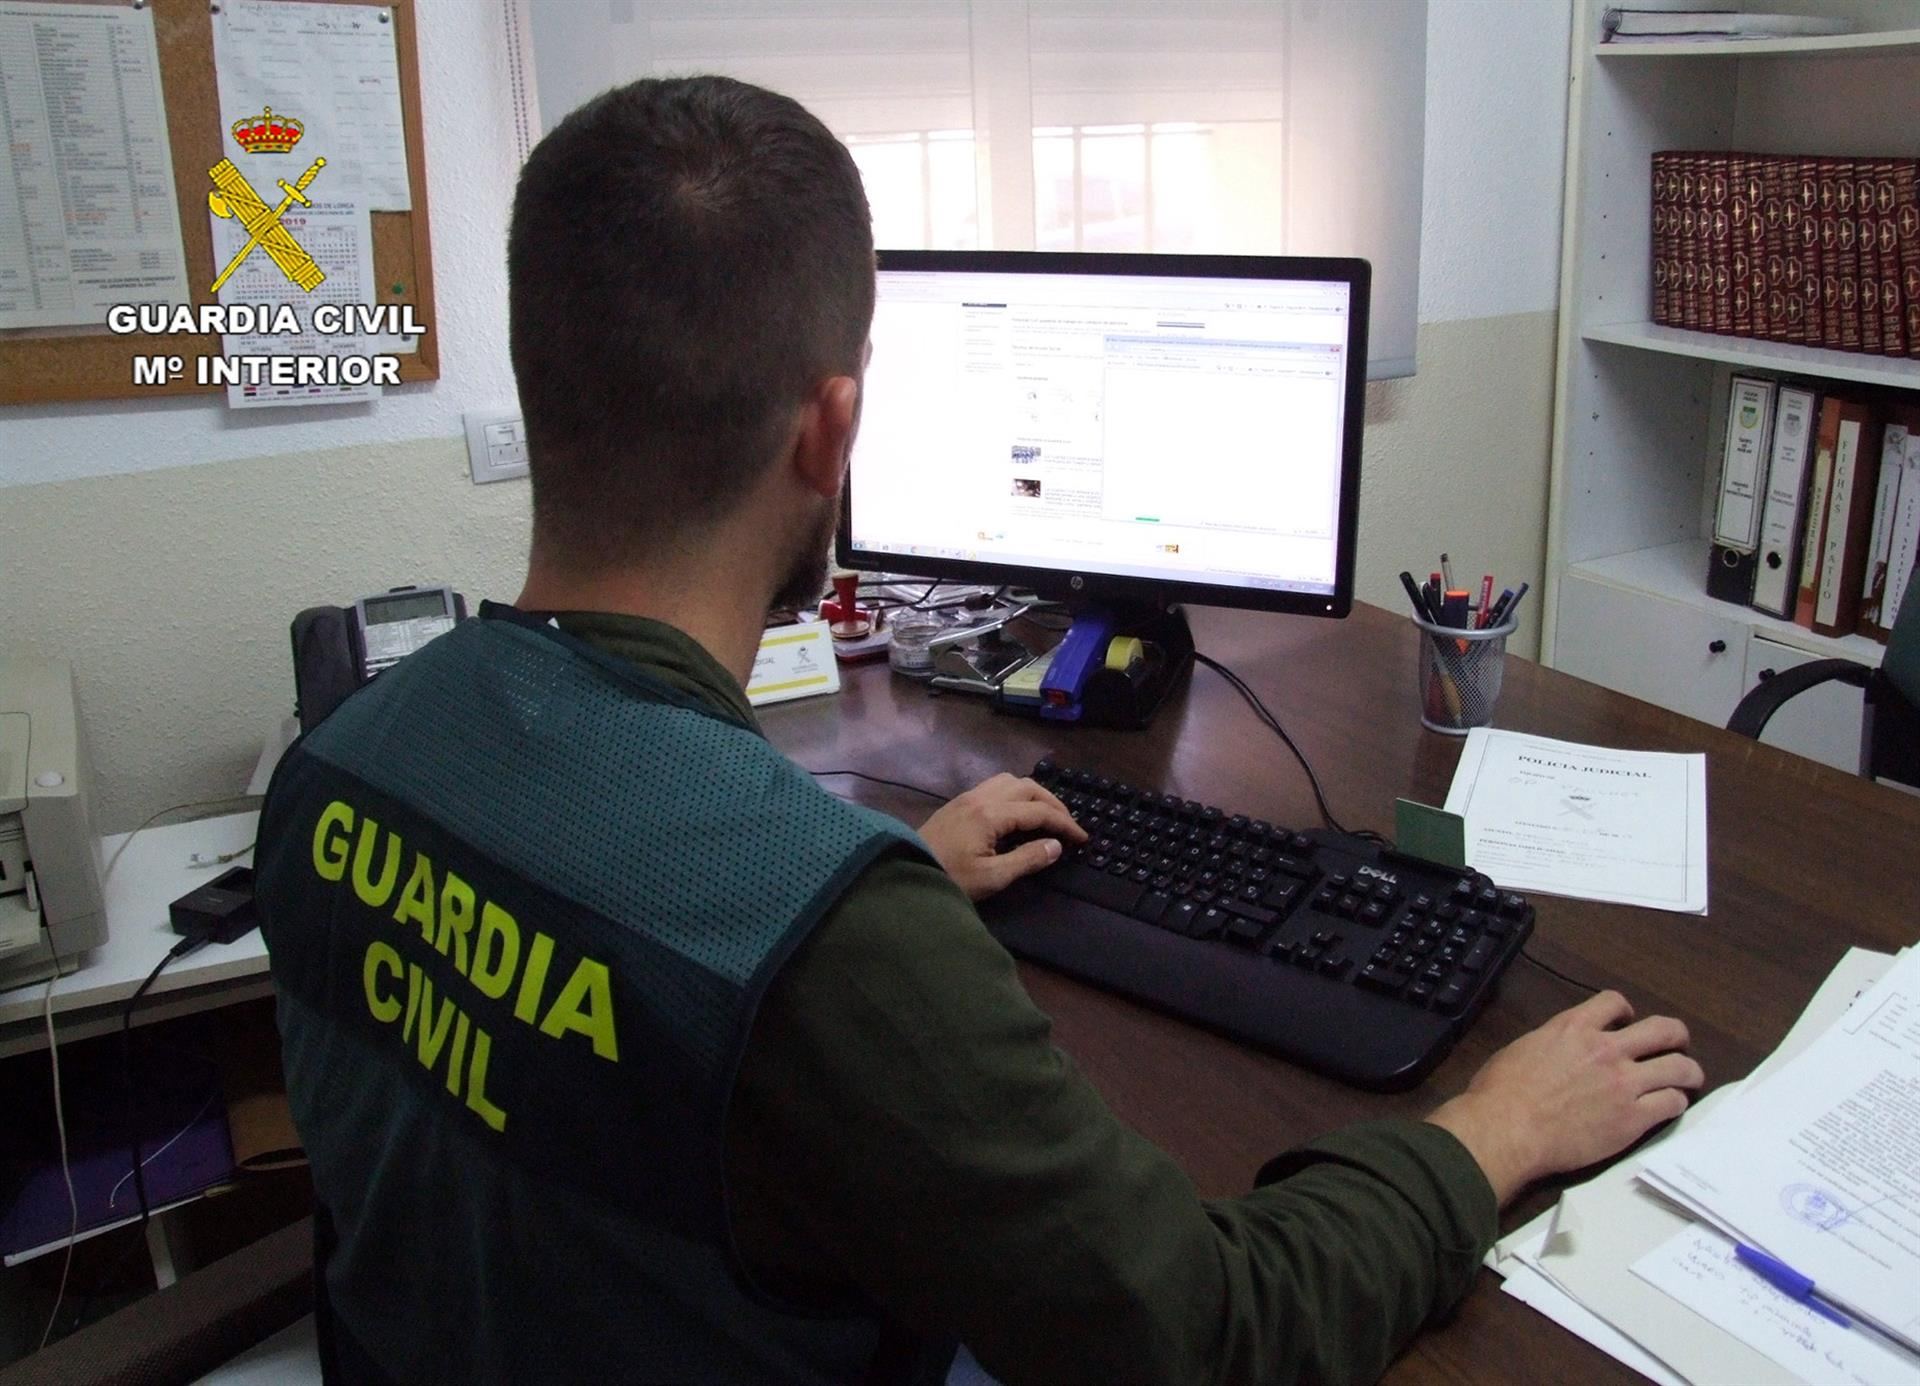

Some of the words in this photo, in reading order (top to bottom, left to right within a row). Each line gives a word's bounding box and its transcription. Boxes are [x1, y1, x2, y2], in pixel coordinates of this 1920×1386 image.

[1517, 755, 1578, 771] POLICIA
[1580, 766, 1652, 779] JUDICIAL
[1358, 865, 1397, 884] DELL
[313, 800, 619, 1063] GUARDIA
[364, 940, 507, 1133] CIVIL
